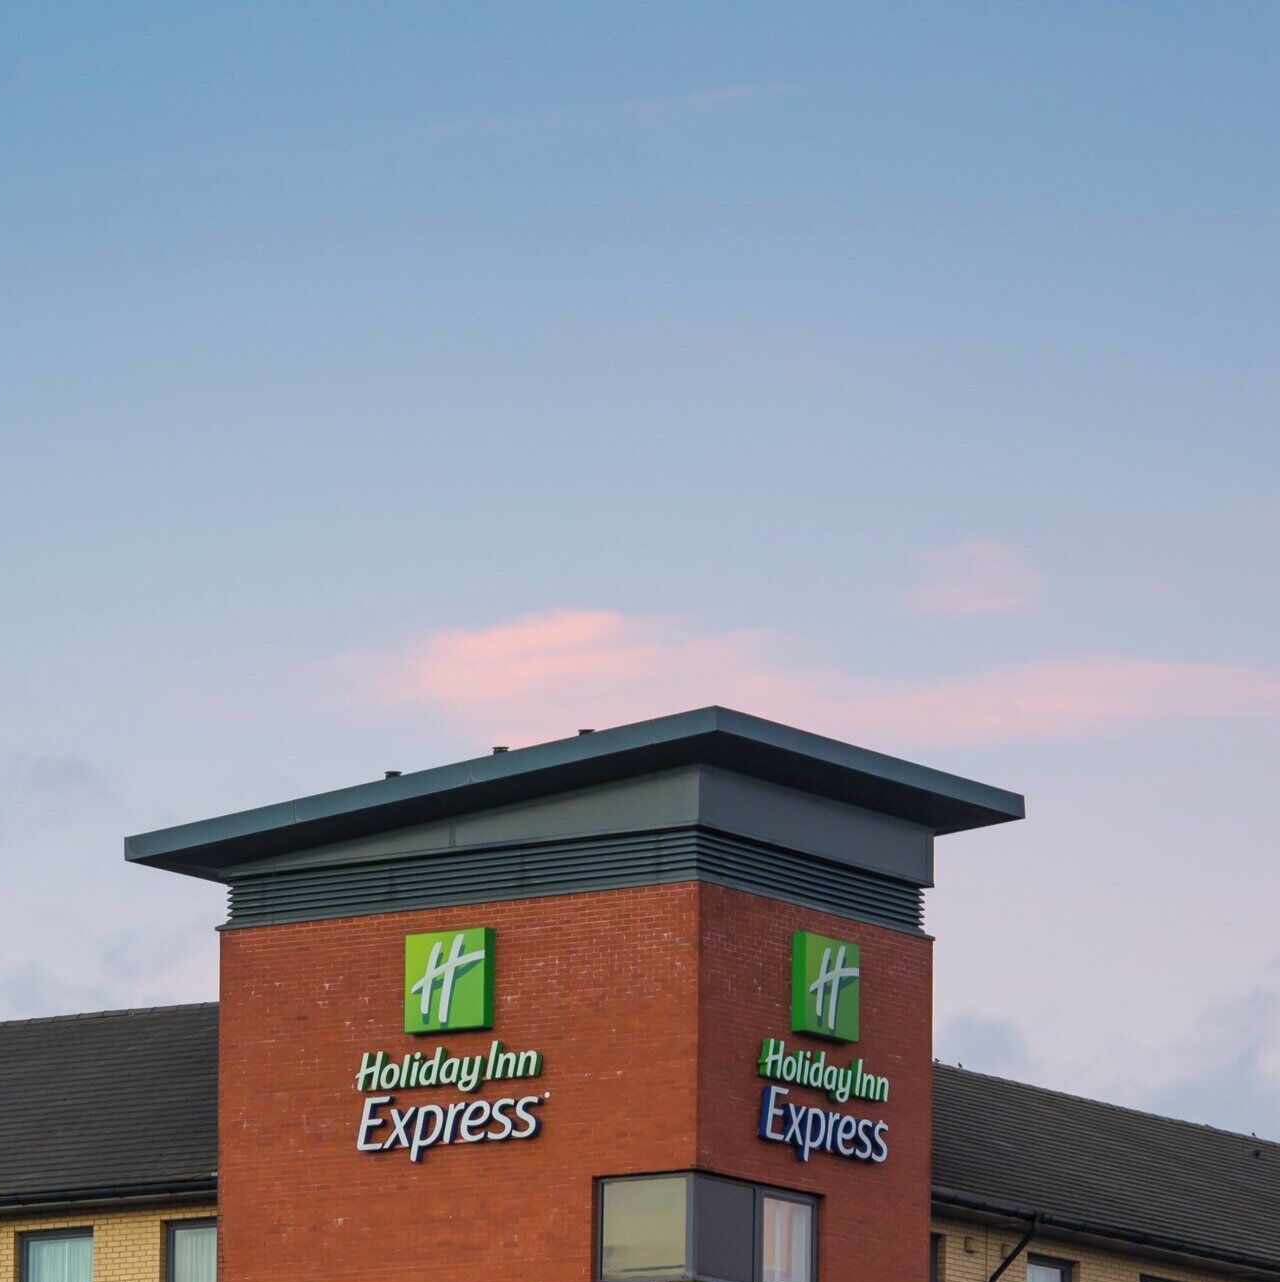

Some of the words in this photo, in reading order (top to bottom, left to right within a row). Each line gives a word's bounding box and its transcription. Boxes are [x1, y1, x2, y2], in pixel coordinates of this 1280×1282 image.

[354, 1046, 484, 1092] Holiday
[486, 1039, 541, 1081] Inn
[761, 1037, 852, 1103] Holiday
[854, 1058, 890, 1103] Inn
[356, 1096, 540, 1163] Express
[762, 1085, 889, 1163] Express
